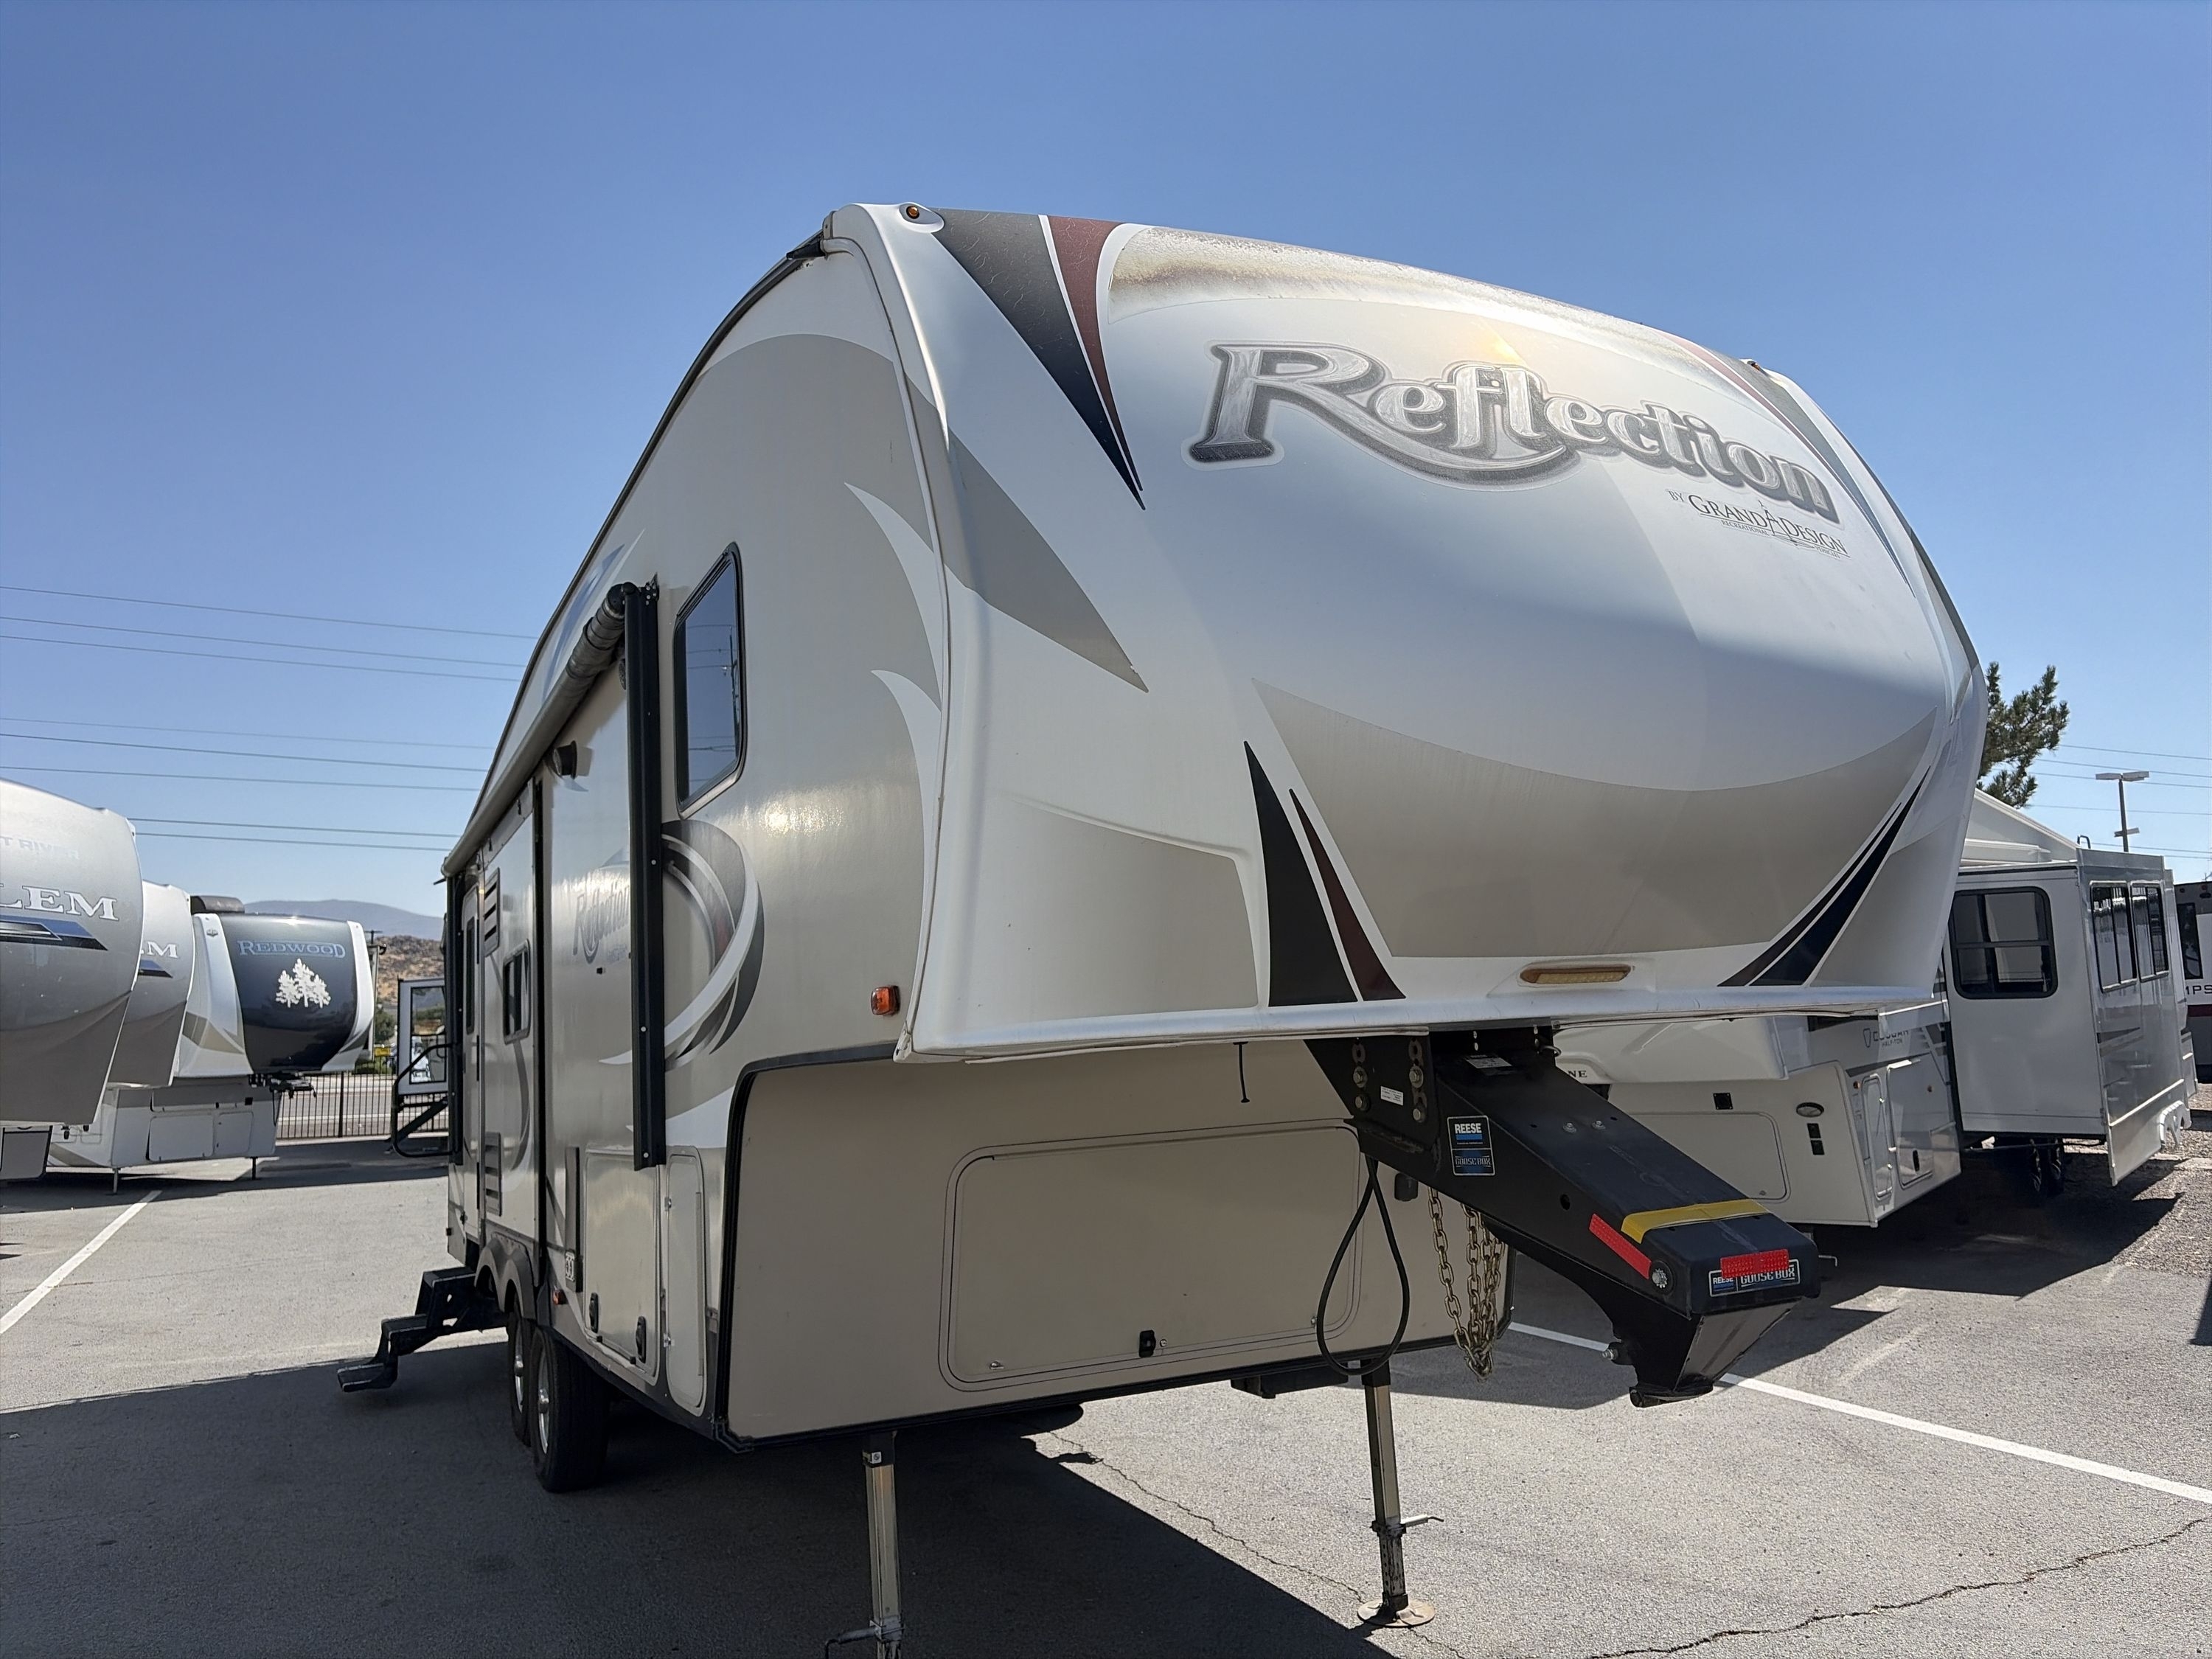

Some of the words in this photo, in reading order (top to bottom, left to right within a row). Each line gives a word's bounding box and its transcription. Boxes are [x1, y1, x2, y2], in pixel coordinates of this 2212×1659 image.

[1189, 344, 1841, 524] Reflection
[1668, 490, 1685, 503] BY
[1688, 494, 1769, 528] GRAND
[1778, 517, 1848, 555] DESIGN
[1721, 520, 1770, 536] RECREATIONAL
[237, 940, 347, 959] REDWOOD
[1454, 1123, 1482, 1134] REESE
[1477, 1157, 1491, 1165] BOX
[1713, 1276, 1734, 1284] REESE
